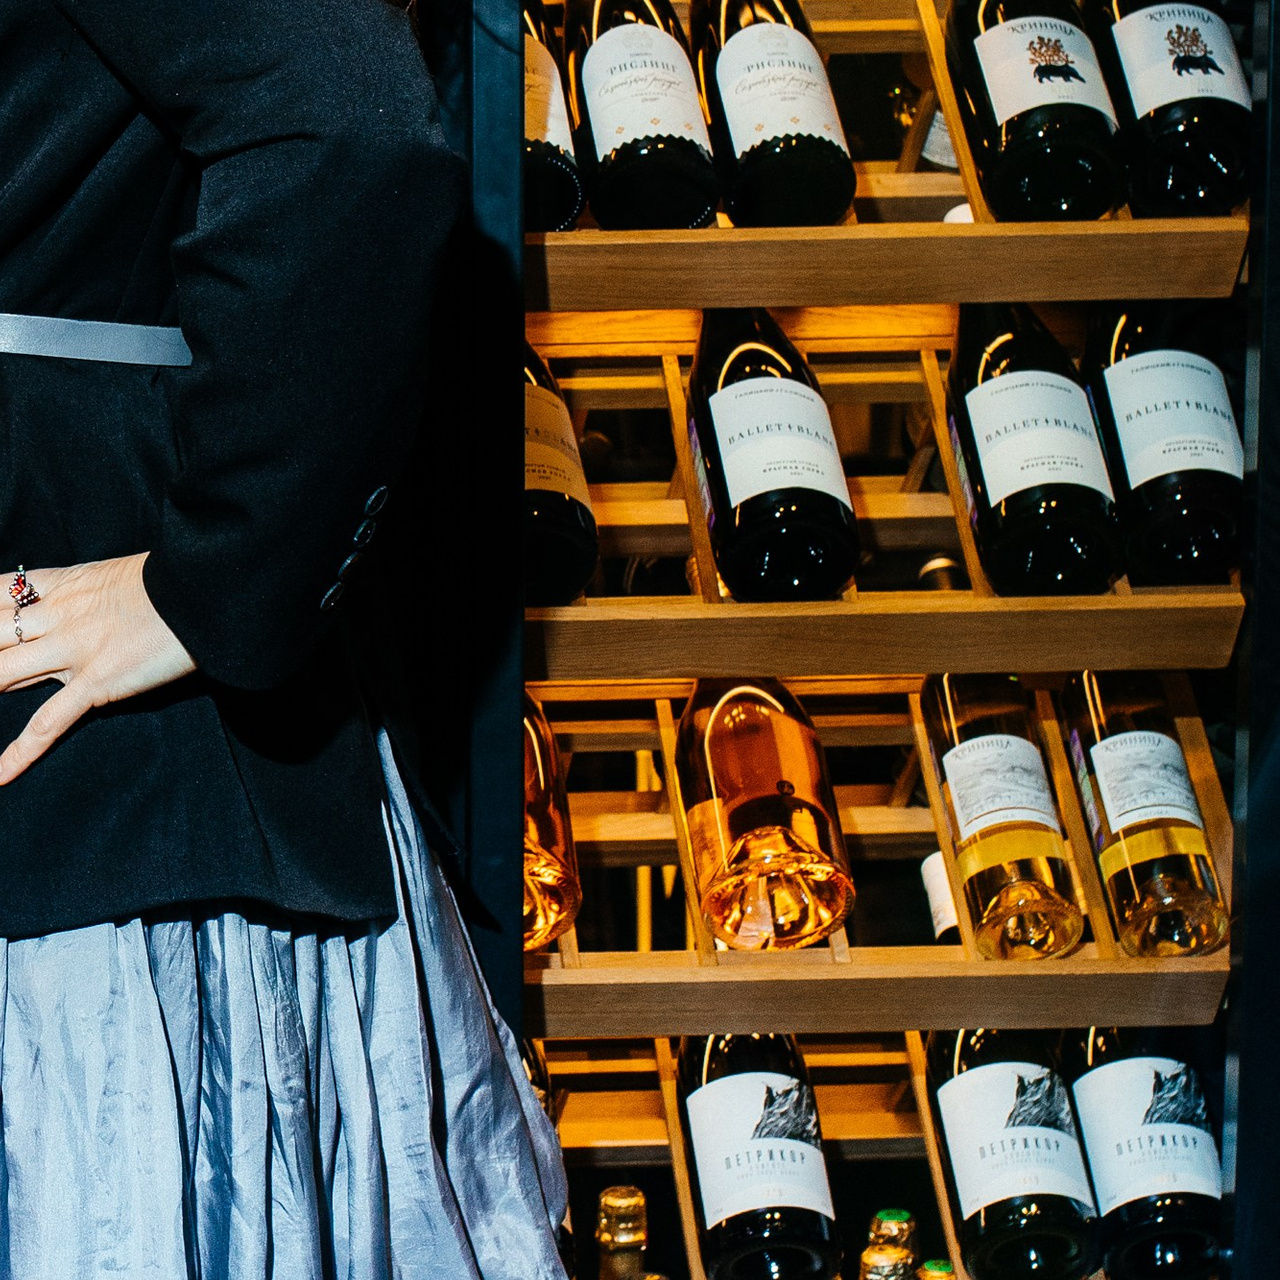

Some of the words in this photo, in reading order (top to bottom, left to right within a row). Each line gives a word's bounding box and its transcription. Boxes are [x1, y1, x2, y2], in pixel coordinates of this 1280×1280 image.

[1124, 400, 1181, 424] BALLET
[1194, 400, 1234, 423] BLANC
[728, 422, 784, 446] BALLET
[796, 425, 835, 447] BLANC
[984, 417, 1040, 444] BALLET
[1053, 417, 1094, 437] BLANC
